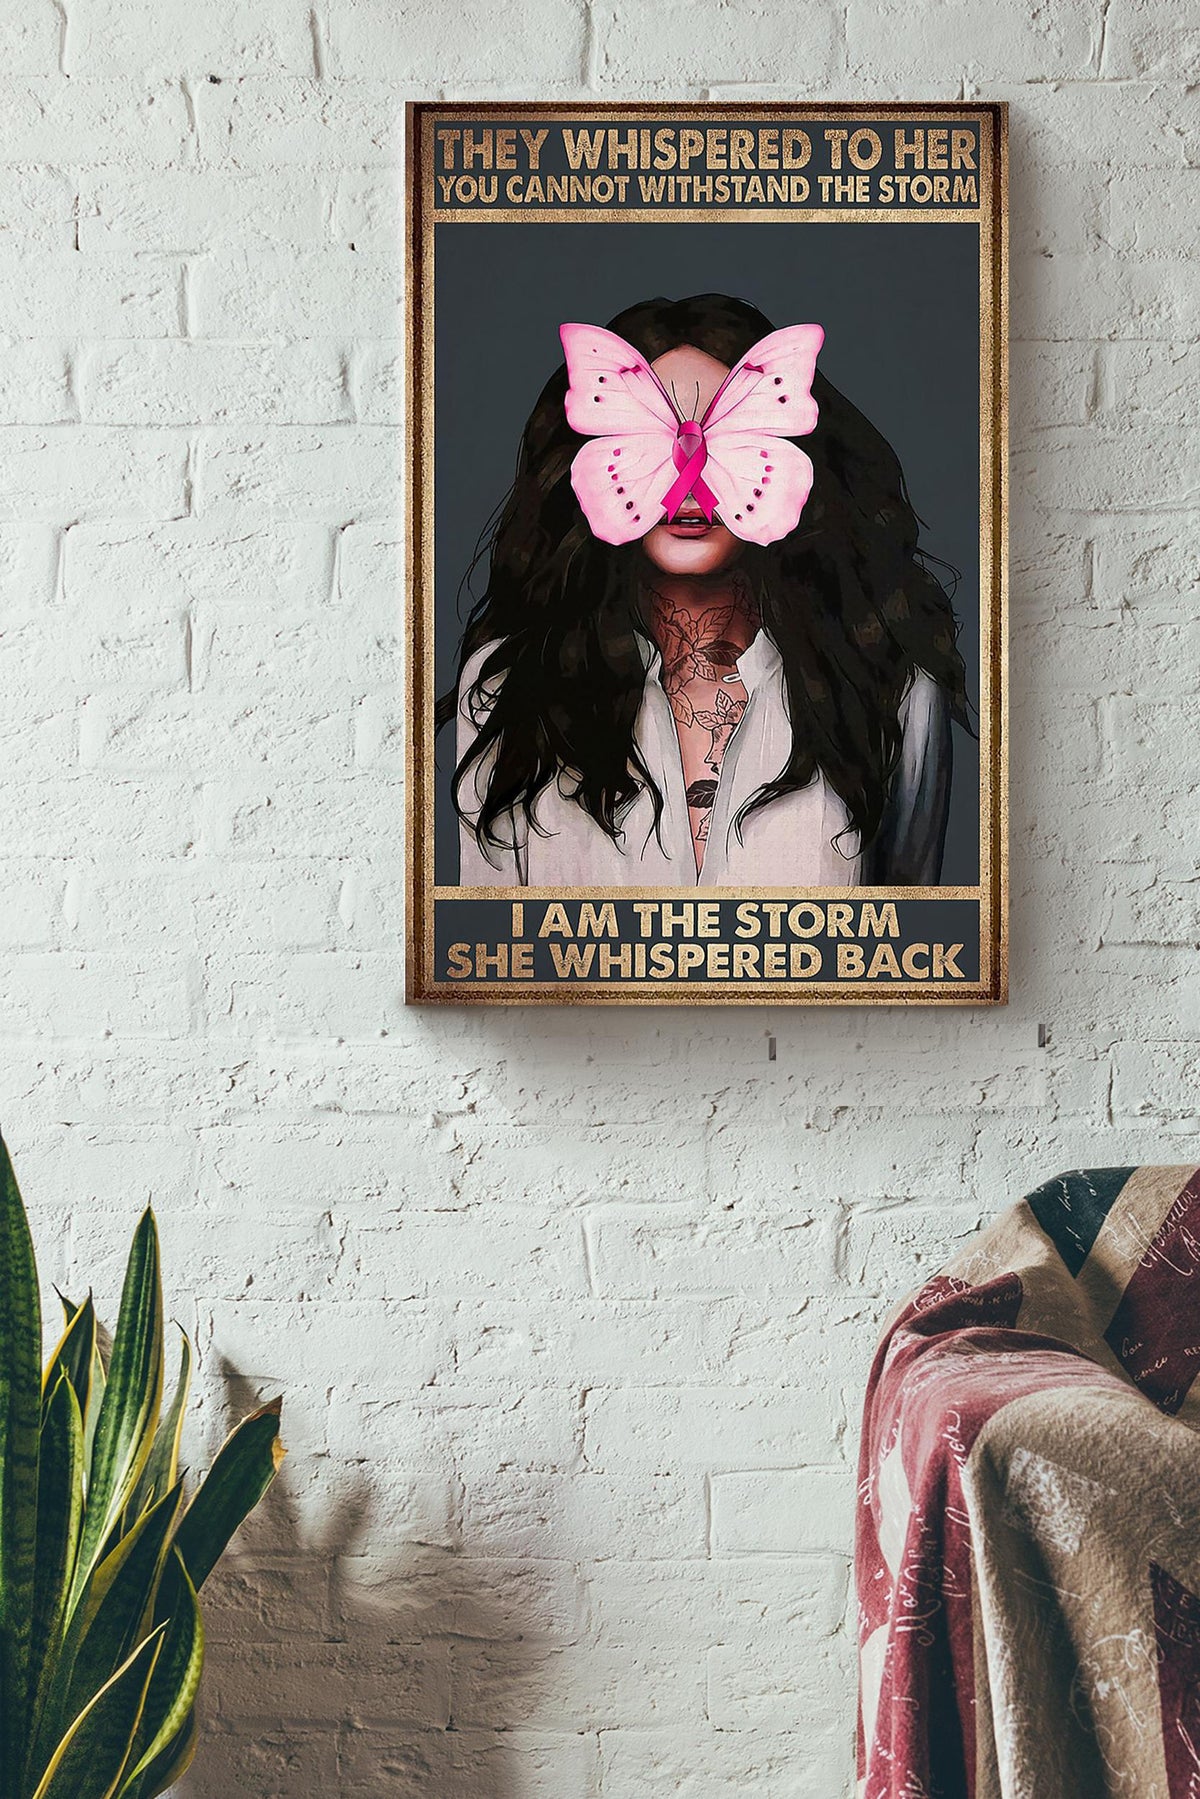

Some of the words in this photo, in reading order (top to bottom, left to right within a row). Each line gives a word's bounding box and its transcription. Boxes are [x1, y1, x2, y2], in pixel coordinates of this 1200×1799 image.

[437, 128, 550, 169] THEY
[561, 128, 812, 169] WHISPERED
[823, 128, 883, 169] TO
[894, 128, 977, 169] HER
[437, 175, 499, 203] YOU
[505, 175, 630, 203] CANNOT
[637, 175, 810, 203] WITHSTAND
[817, 175, 870, 203] THE
[878, 175, 978, 203] STORM
[511, 902, 524, 937] I
[537, 902, 620, 937] AM
[632, 902, 721, 937] THE
[735, 902, 901, 937] STORM
[447, 943, 535, 978] SHE
[549, 943, 823, 978] WHISPERED
[836, 943, 965, 978] BACK
